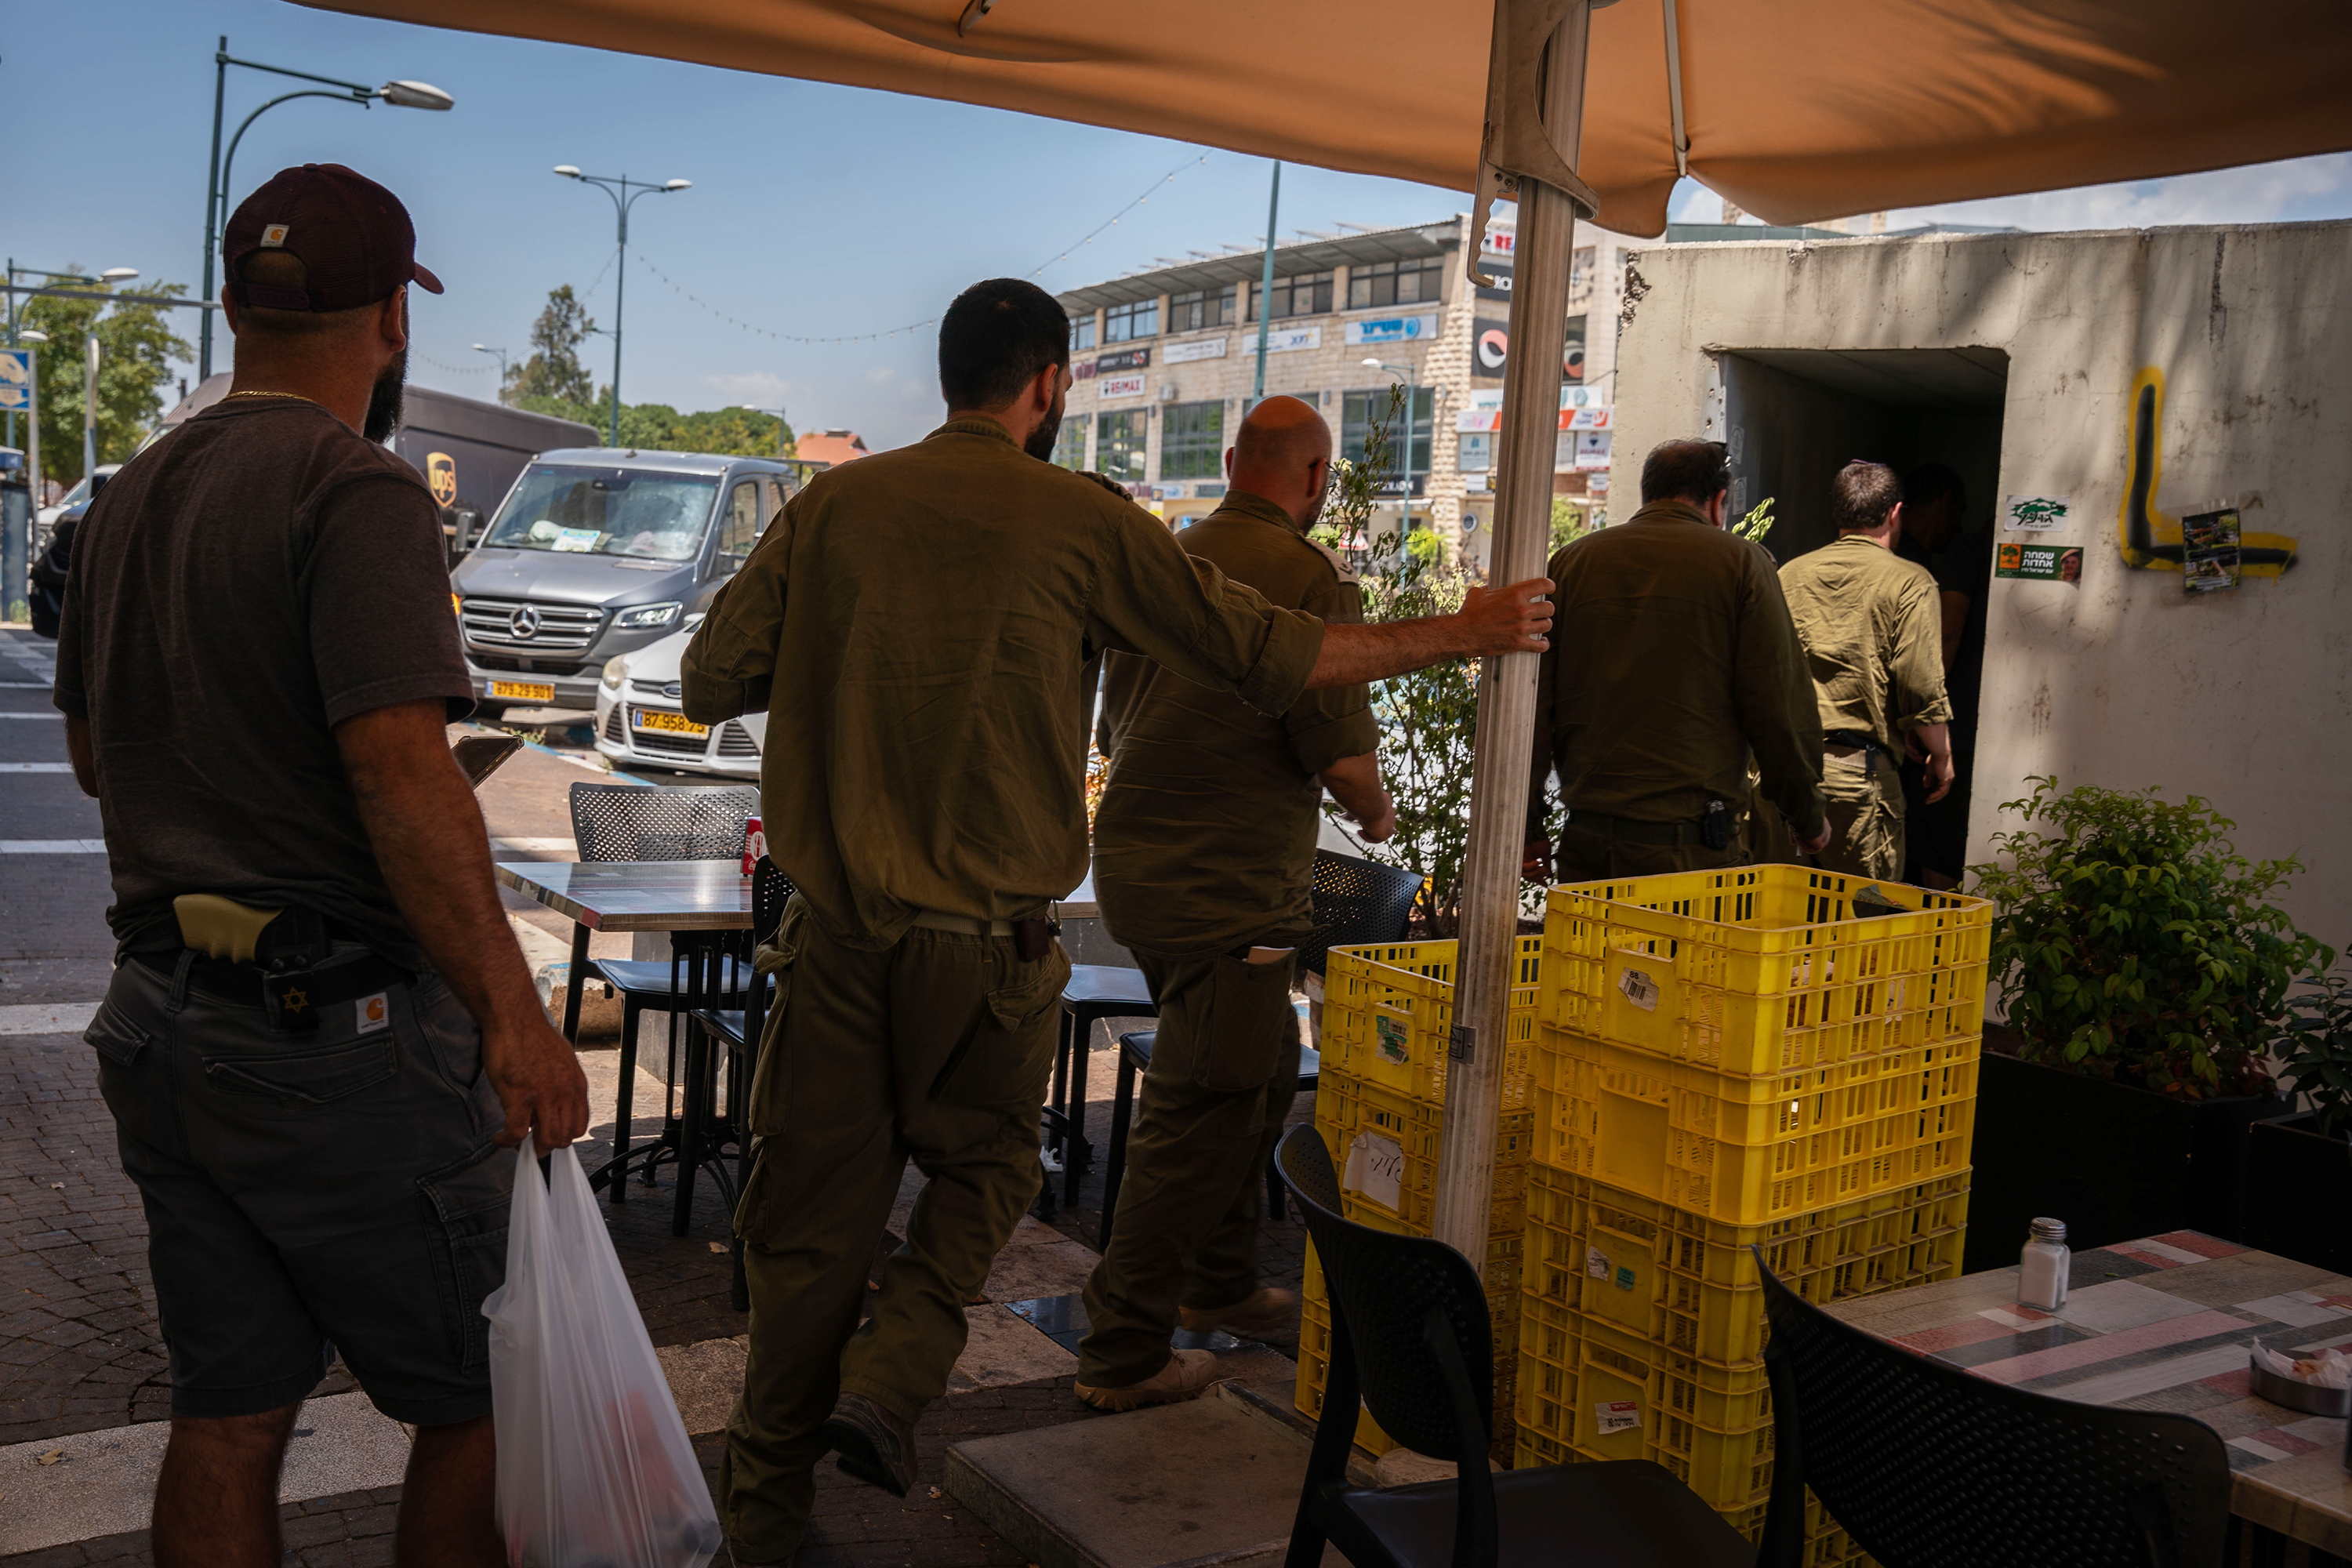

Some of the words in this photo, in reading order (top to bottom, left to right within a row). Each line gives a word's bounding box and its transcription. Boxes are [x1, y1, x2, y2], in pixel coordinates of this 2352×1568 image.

[431, 469, 455, 499] ups
[2024, 551, 2054, 560] שמחה
[2022, 559, 2053, 568] אחדות
